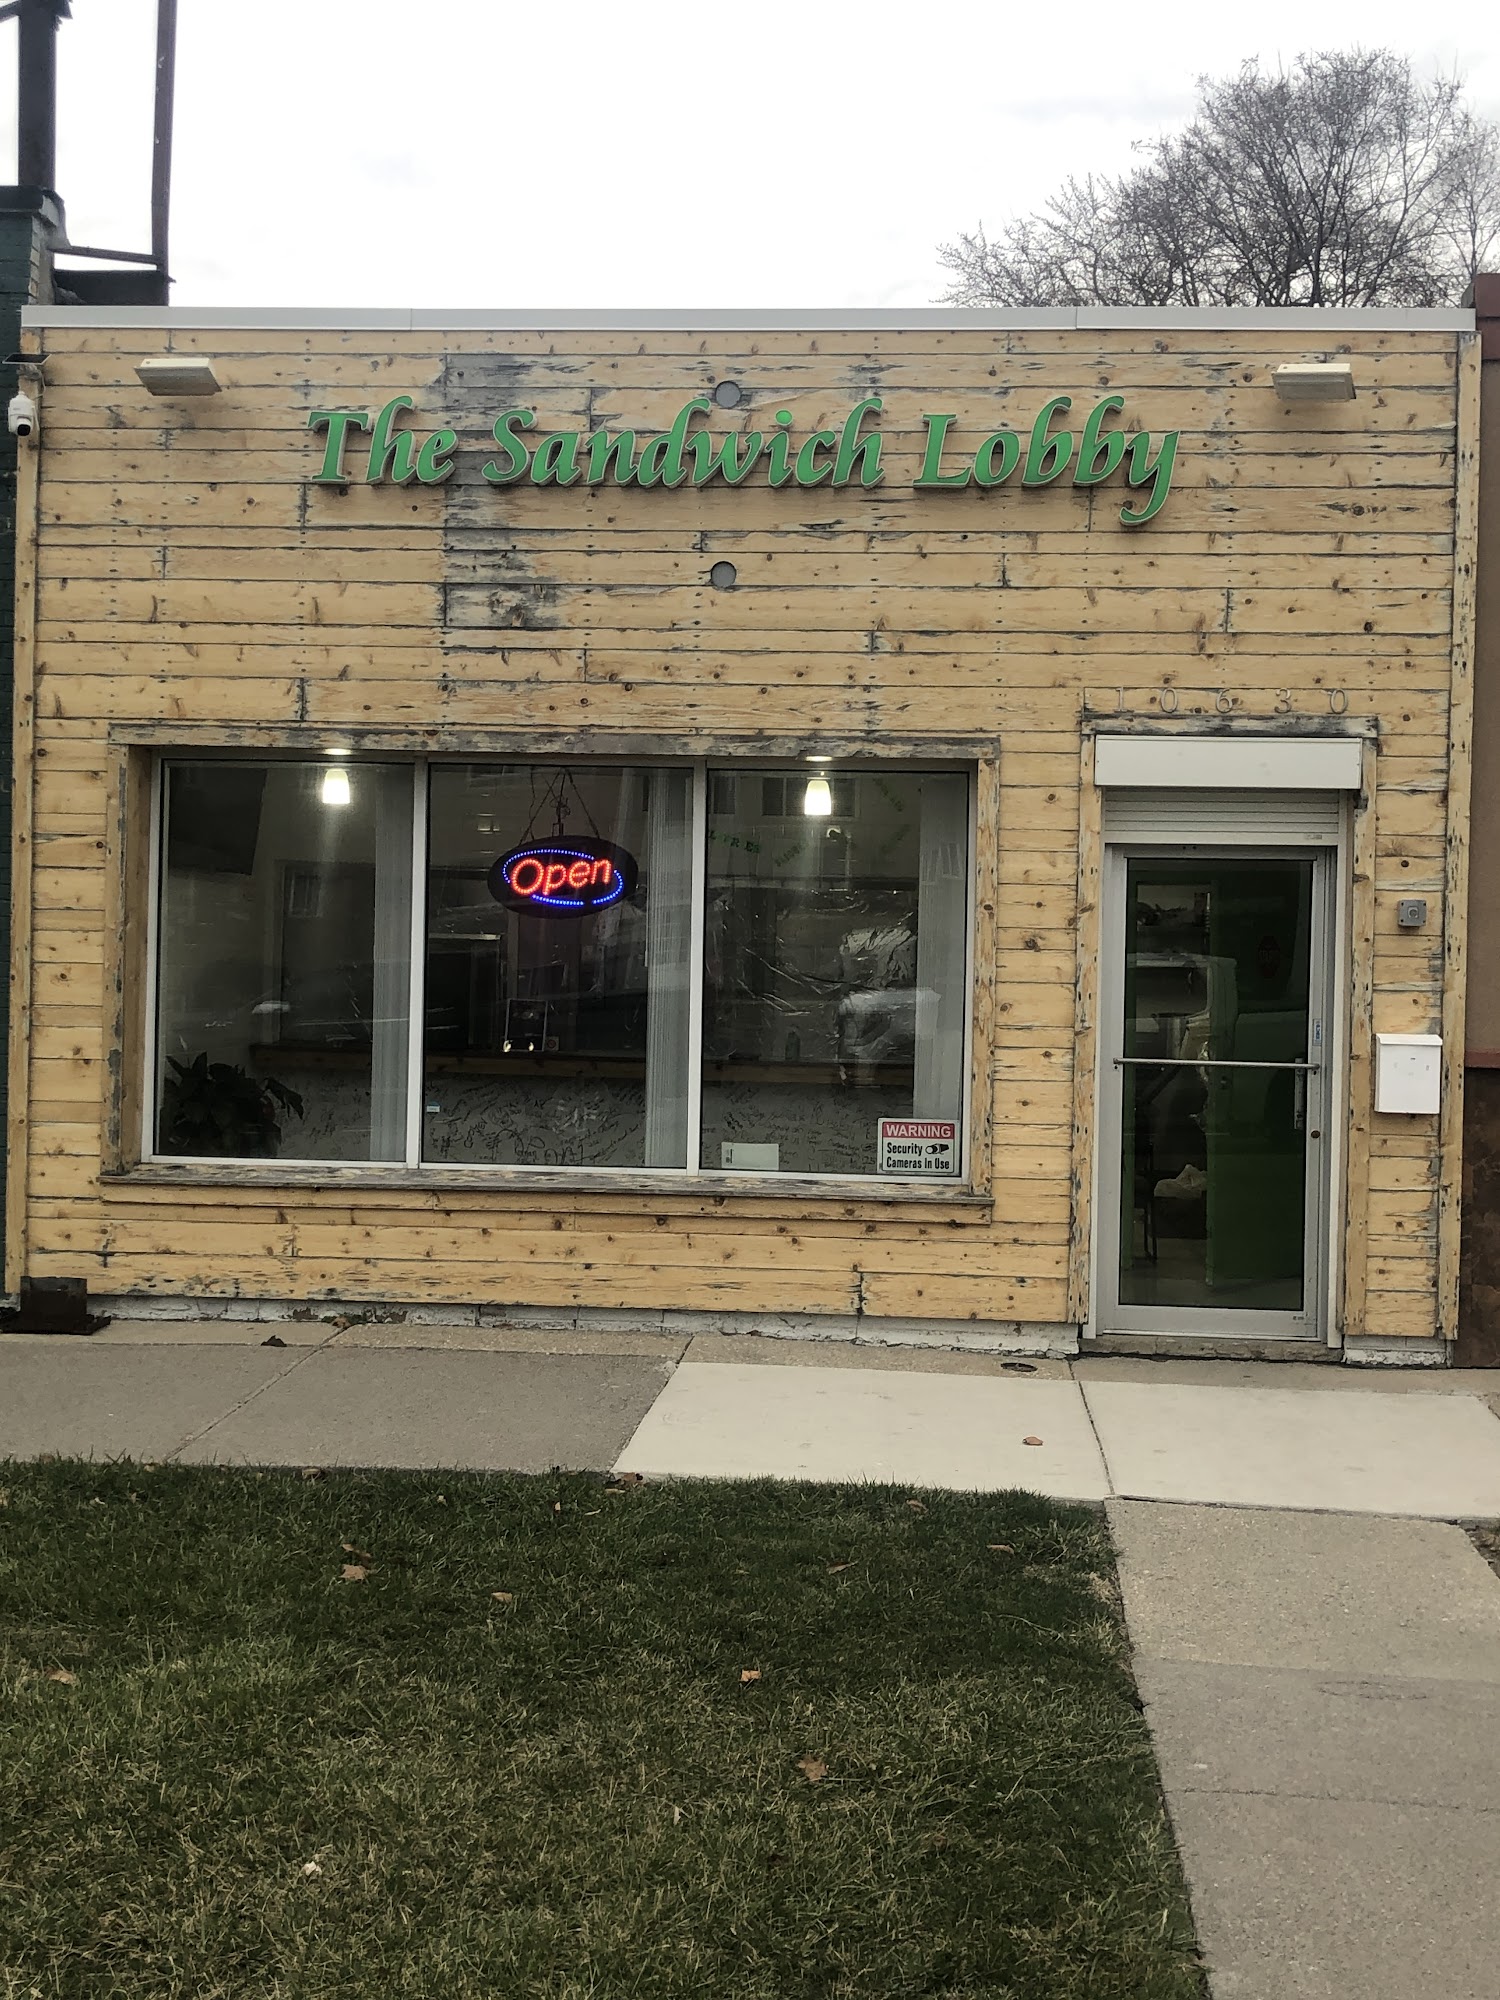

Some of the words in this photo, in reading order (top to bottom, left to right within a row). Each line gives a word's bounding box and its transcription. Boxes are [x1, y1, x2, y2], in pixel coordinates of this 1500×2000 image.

[308, 395, 458, 484] The
[482, 397, 886, 487] Sandwich
[913, 395, 1181, 526] Lobby
[1114, 686, 1349, 715] 10630
[511, 857, 613, 897] Open
[886, 1124, 952, 1138] WARNING
[886, 1142, 923, 1157] Security
[886, 1156, 922, 1169] Cameras
[924, 1157, 933, 1169] In
[934, 1157, 950, 1170] Use
